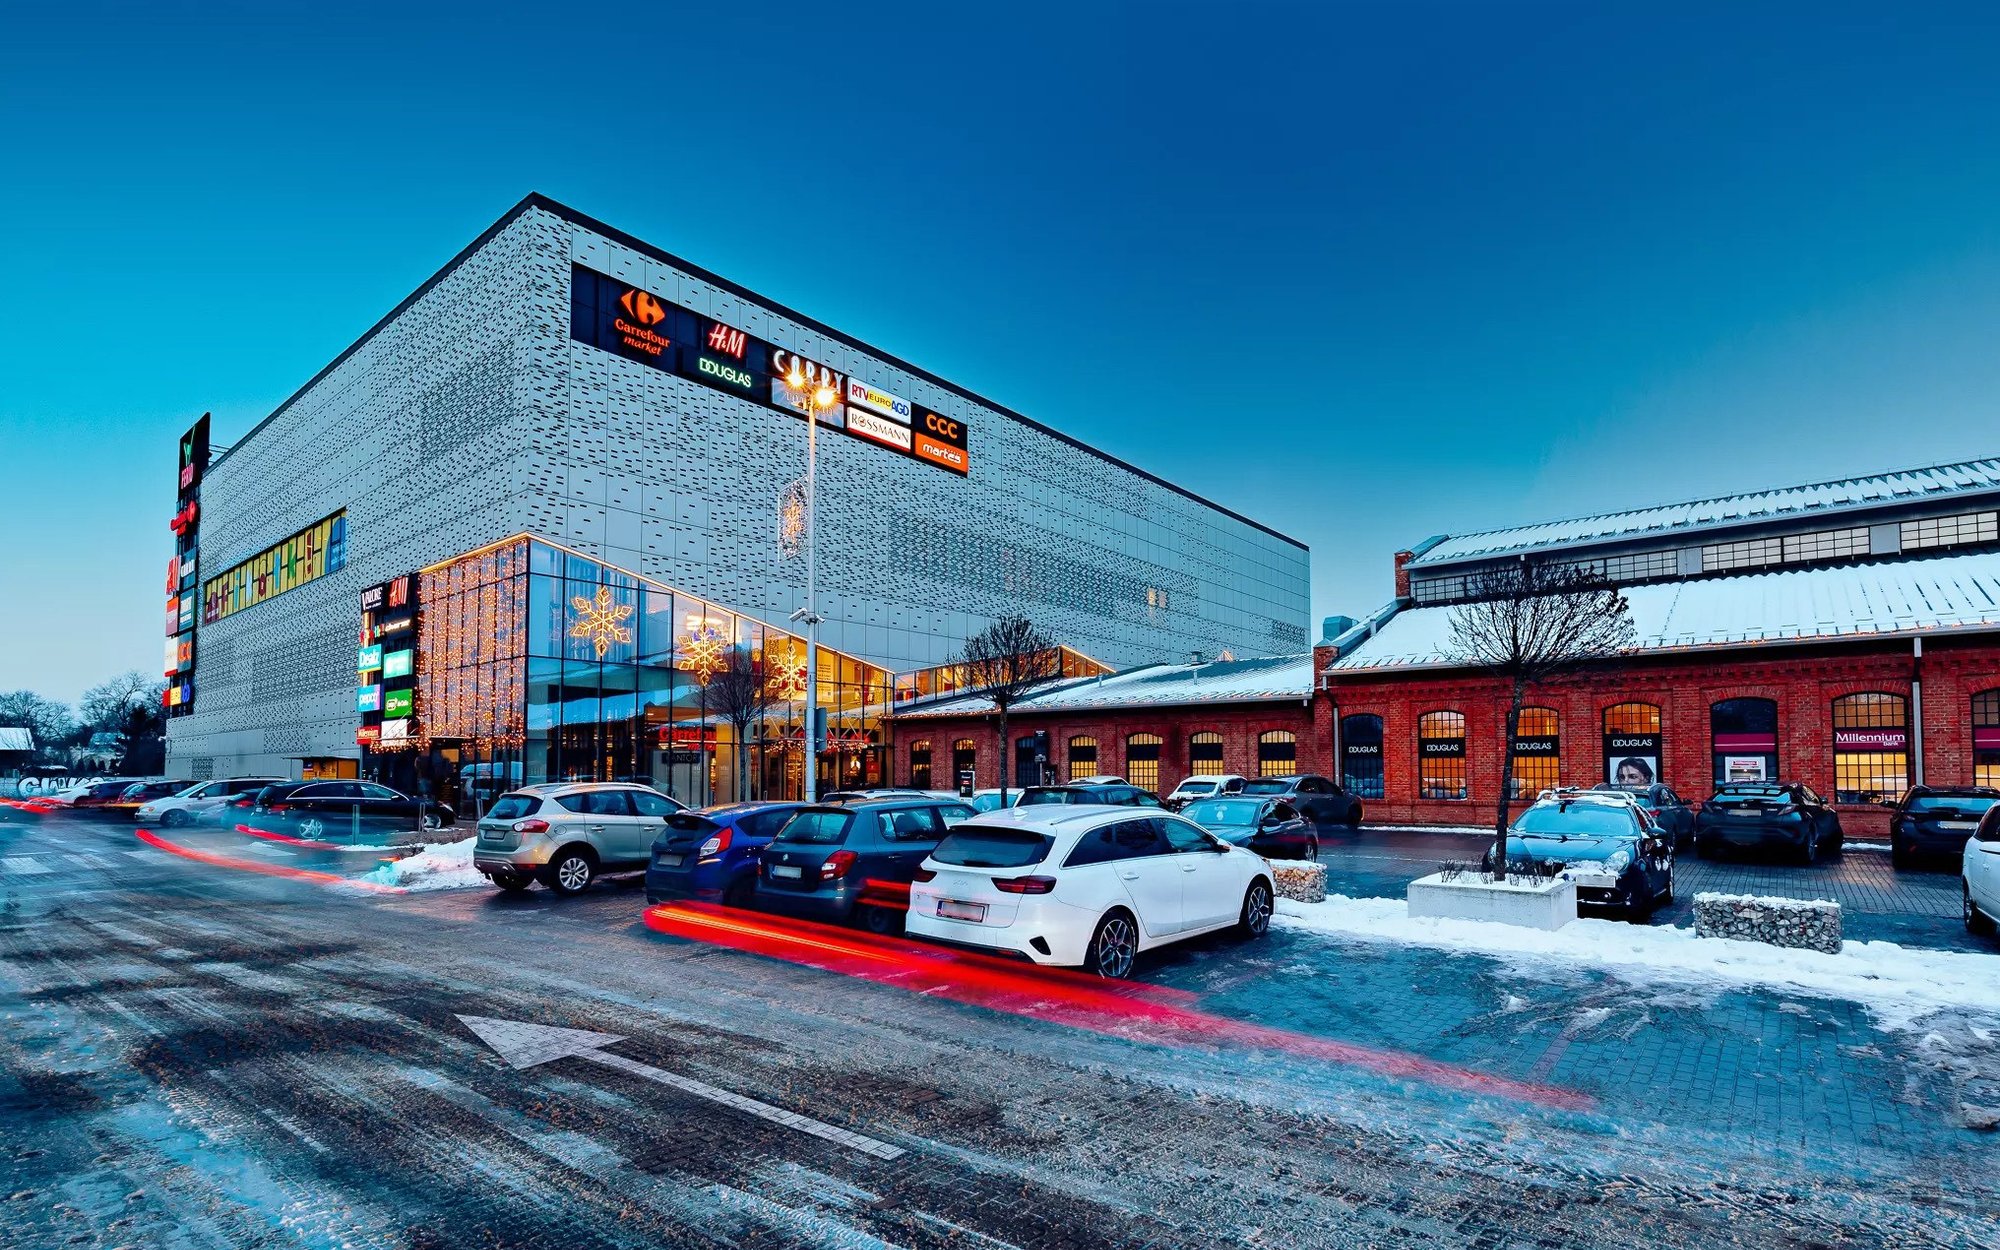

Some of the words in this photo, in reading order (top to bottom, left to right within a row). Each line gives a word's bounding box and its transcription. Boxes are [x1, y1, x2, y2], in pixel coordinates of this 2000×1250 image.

[614, 318, 671, 348] Carrefour
[709, 323, 745, 358] H&M
[624, 336, 662, 356] market
[699, 358, 752, 388] DOUGLAS
[851, 383, 869, 401] RTV
[869, 393, 891, 407] EURO
[891, 400, 910, 417] AGD
[851, 413, 910, 443] ROSSMANN
[926, 413, 958, 440] CCC
[922, 443, 962, 464] martes
[1515, 742, 1552, 750] DOUGLAS
[1612, 738, 1653, 747] DOUGLAS
[1835, 731, 1906, 742] Millennium
[667, 754, 698, 762] ANTOR
[1426, 744, 1459, 752] DOUGLAS
